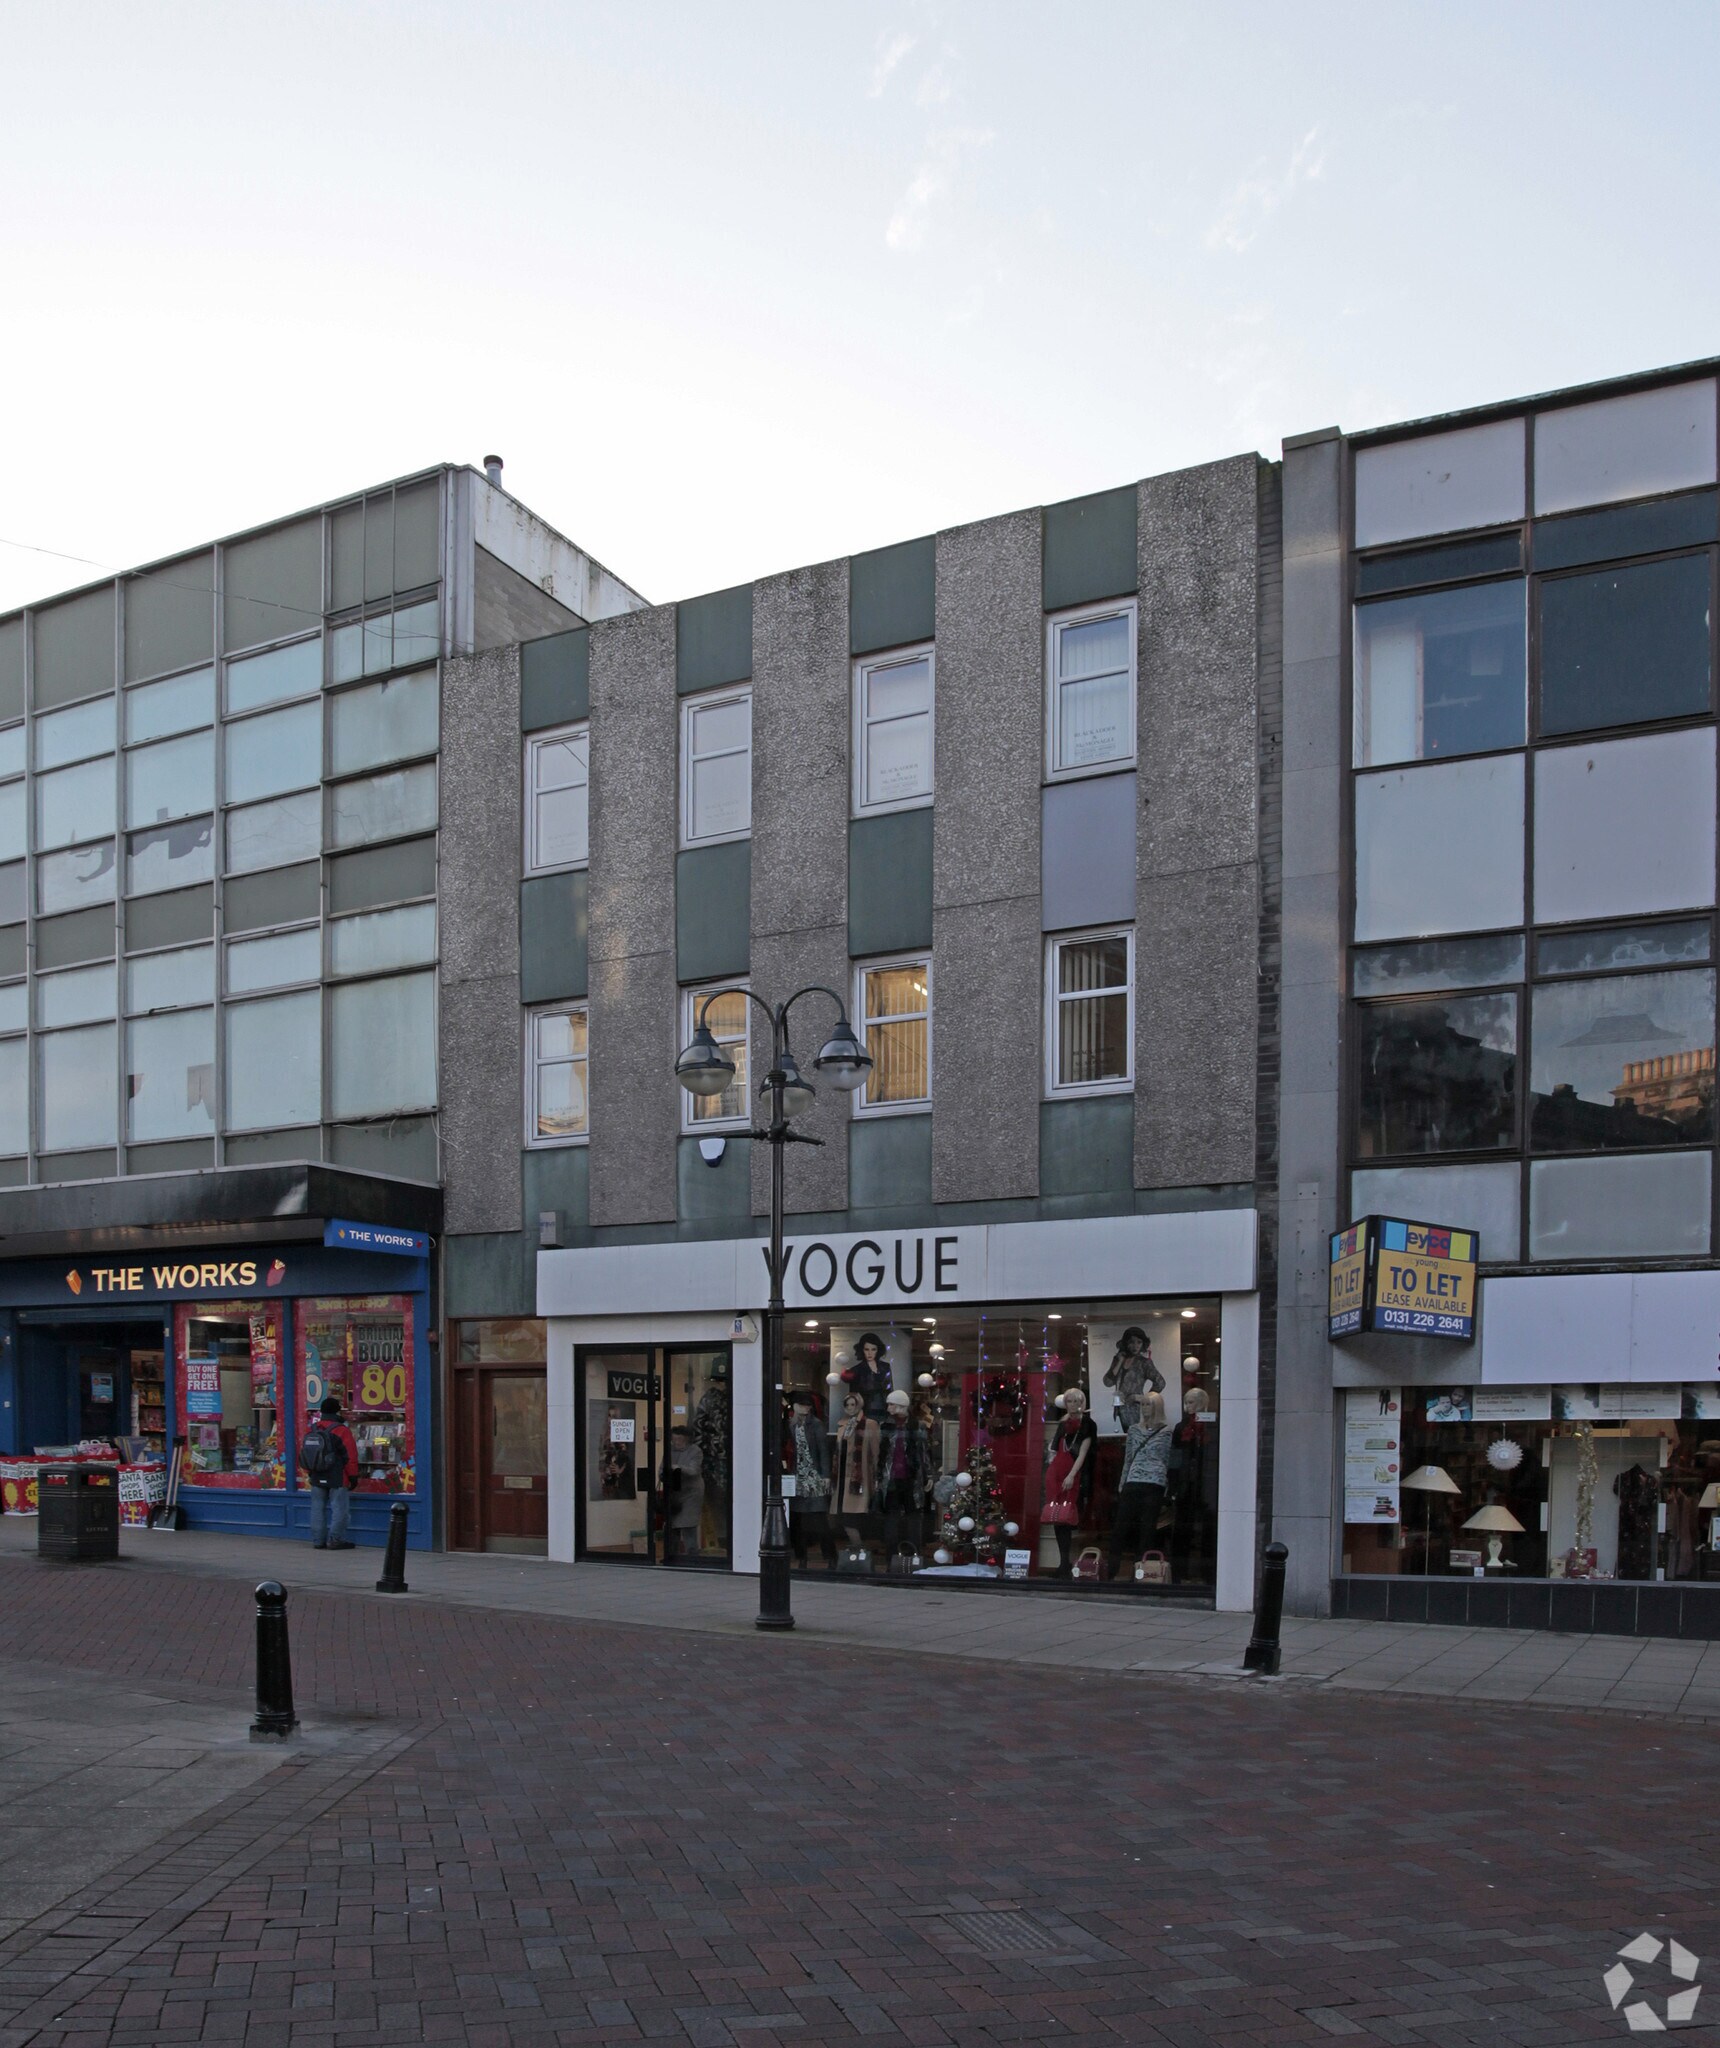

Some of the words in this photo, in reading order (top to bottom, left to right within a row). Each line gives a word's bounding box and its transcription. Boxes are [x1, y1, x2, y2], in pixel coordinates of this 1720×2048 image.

[348, 1230, 371, 1243] THE
[374, 1234, 414, 1248] WORKS
[1407, 1230, 1451, 1250] eyco
[92, 1267, 144, 1292] THE
[152, 1261, 257, 1289] WORKS
[762, 1236, 958, 1298] VOGUE
[1390, 1266, 1418, 1293] TO
[1426, 1271, 1462, 1298] LET
[1381, 1291, 1411, 1307] LEASE
[1414, 1296, 1467, 1314] AVAILABLE
[1384, 1310, 1409, 1324] 0131
[1413, 1313, 1435, 1327] 226
[1438, 1316, 1463, 1330] 2641
[187, 1365, 201, 1373] BUY
[202, 1365, 218, 1373] ONE
[187, 1372, 201, 1380] GET
[202, 1372, 218, 1380] ONE
[187, 1380, 218, 1390] FREE!
[361, 1364, 406, 1407] 80
[120, 1489, 144, 1500] HERE
